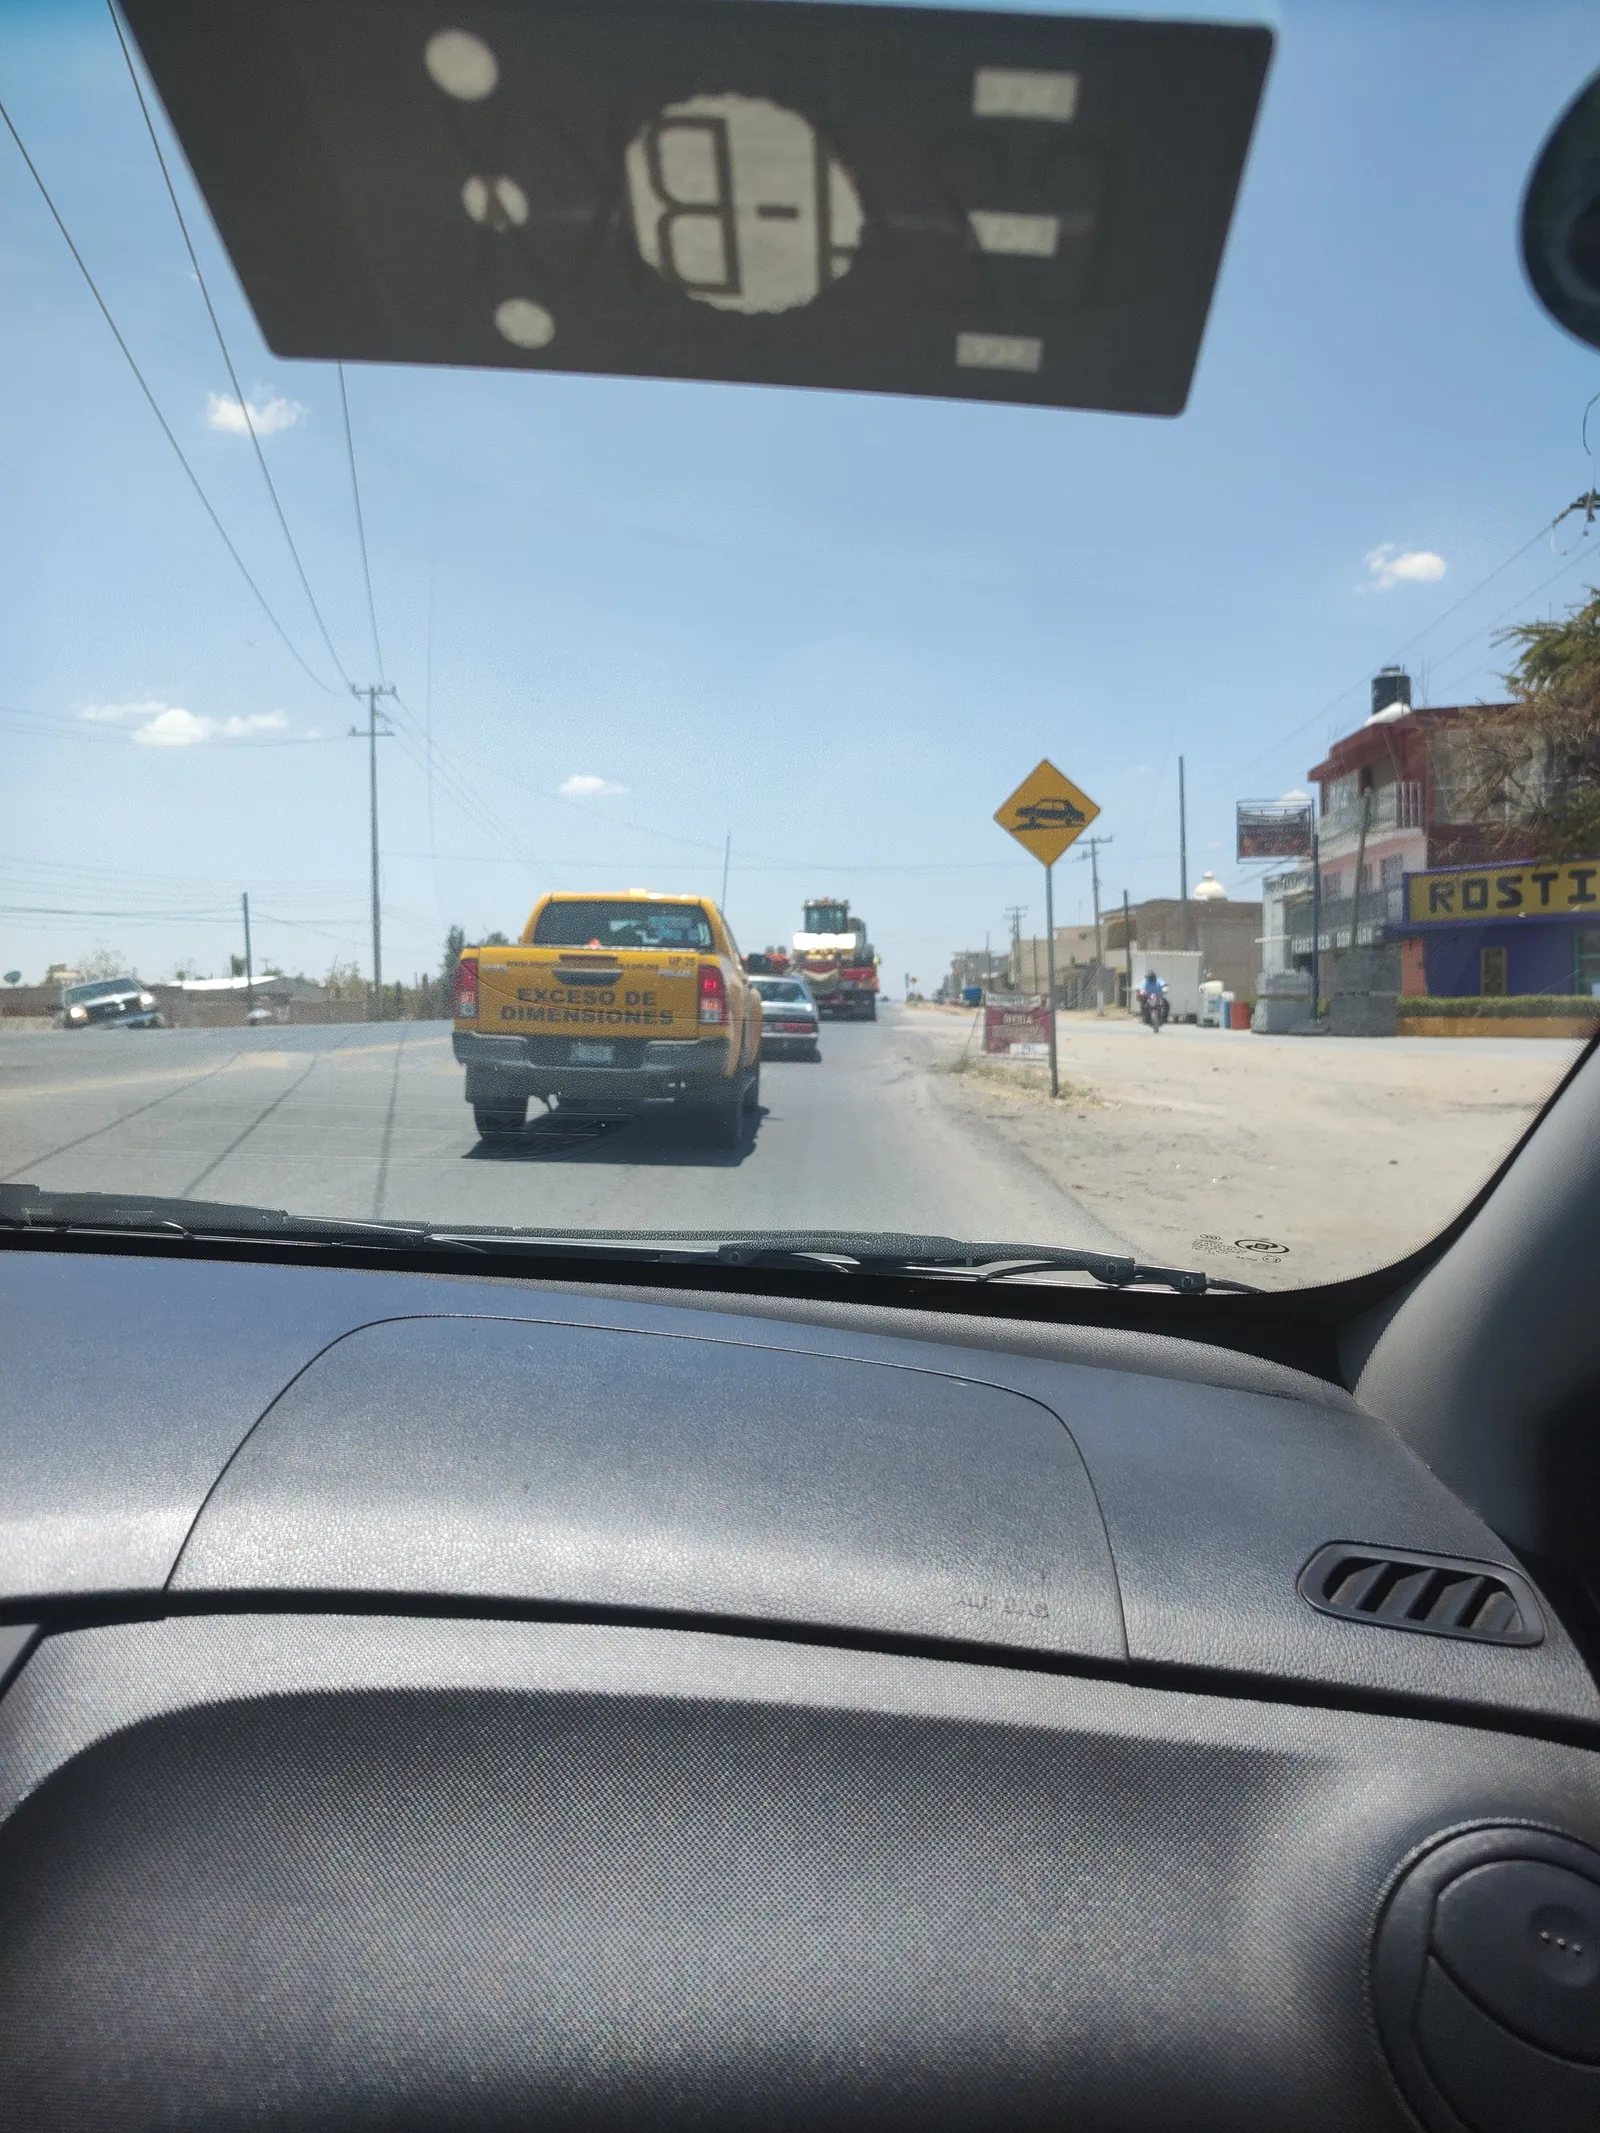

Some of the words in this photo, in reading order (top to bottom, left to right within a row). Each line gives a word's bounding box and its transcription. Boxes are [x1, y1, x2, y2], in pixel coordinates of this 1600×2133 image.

[1429, 869, 1597, 913] ROSTI
[518, 988, 616, 1005] EXCESO
[625, 991, 657, 1006] DE
[501, 1006, 673, 1025] DIMENSIONES
[1003, 1013, 1033, 1025] OFERTA
